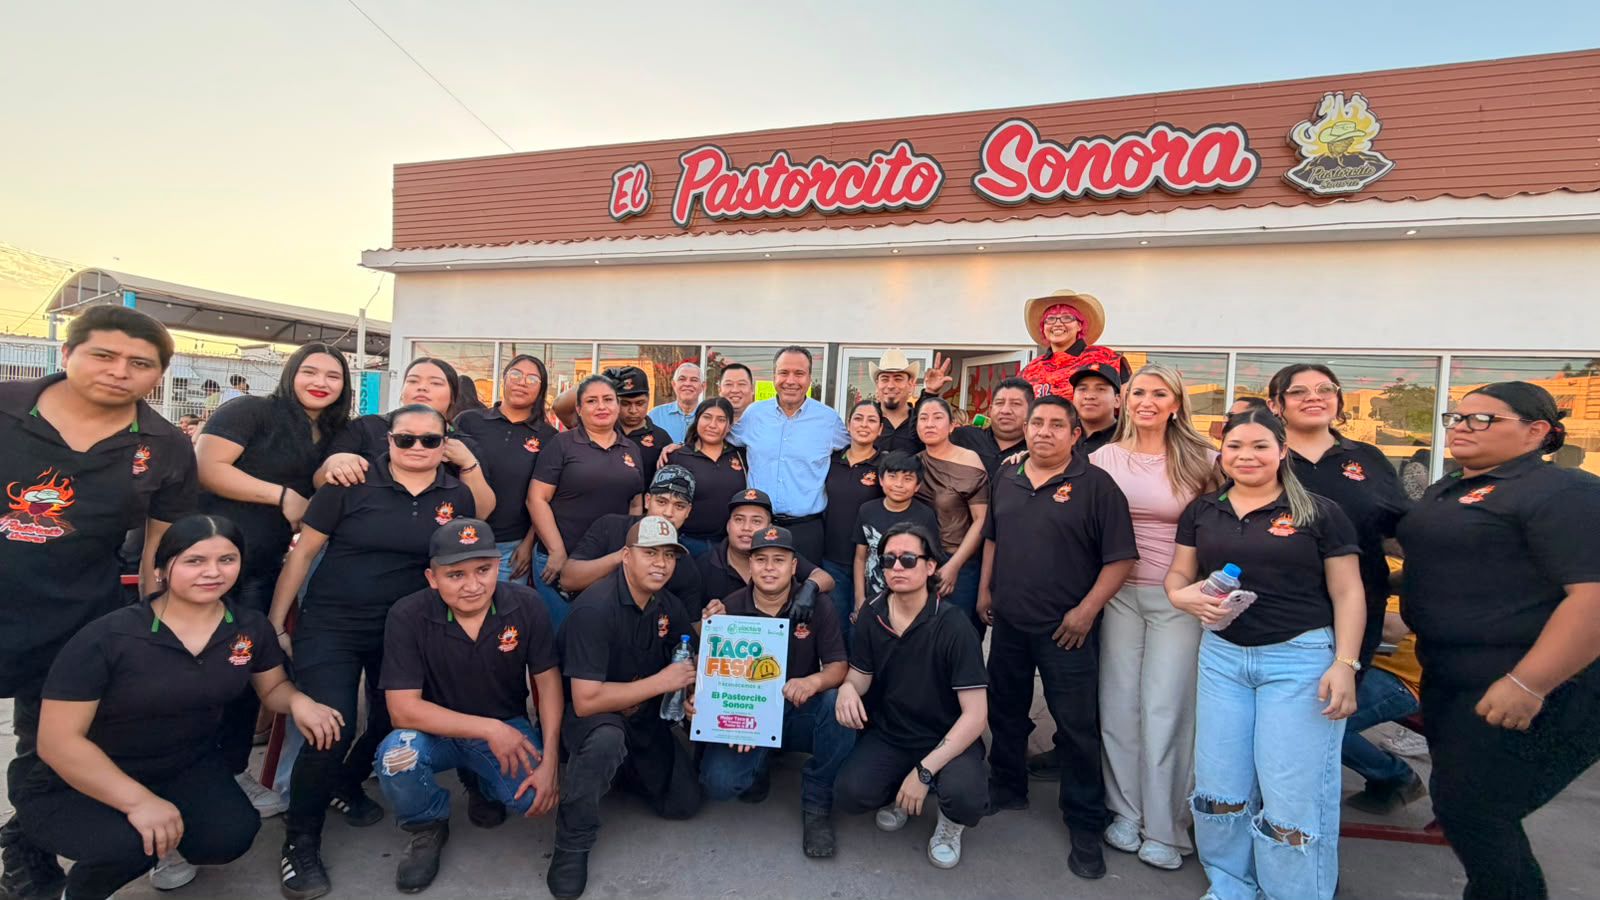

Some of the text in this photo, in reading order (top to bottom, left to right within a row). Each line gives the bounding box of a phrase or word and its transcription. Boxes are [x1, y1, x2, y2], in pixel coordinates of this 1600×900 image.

[611, 120, 1257, 225] El Pastorcito Sonora
[657, 521, 671, 536] B
[707, 635, 763, 659] TACO
[705, 657, 754, 678] FEST
[711, 691, 767, 702] El Pastorcito
[722, 700, 754, 710] Sonora
